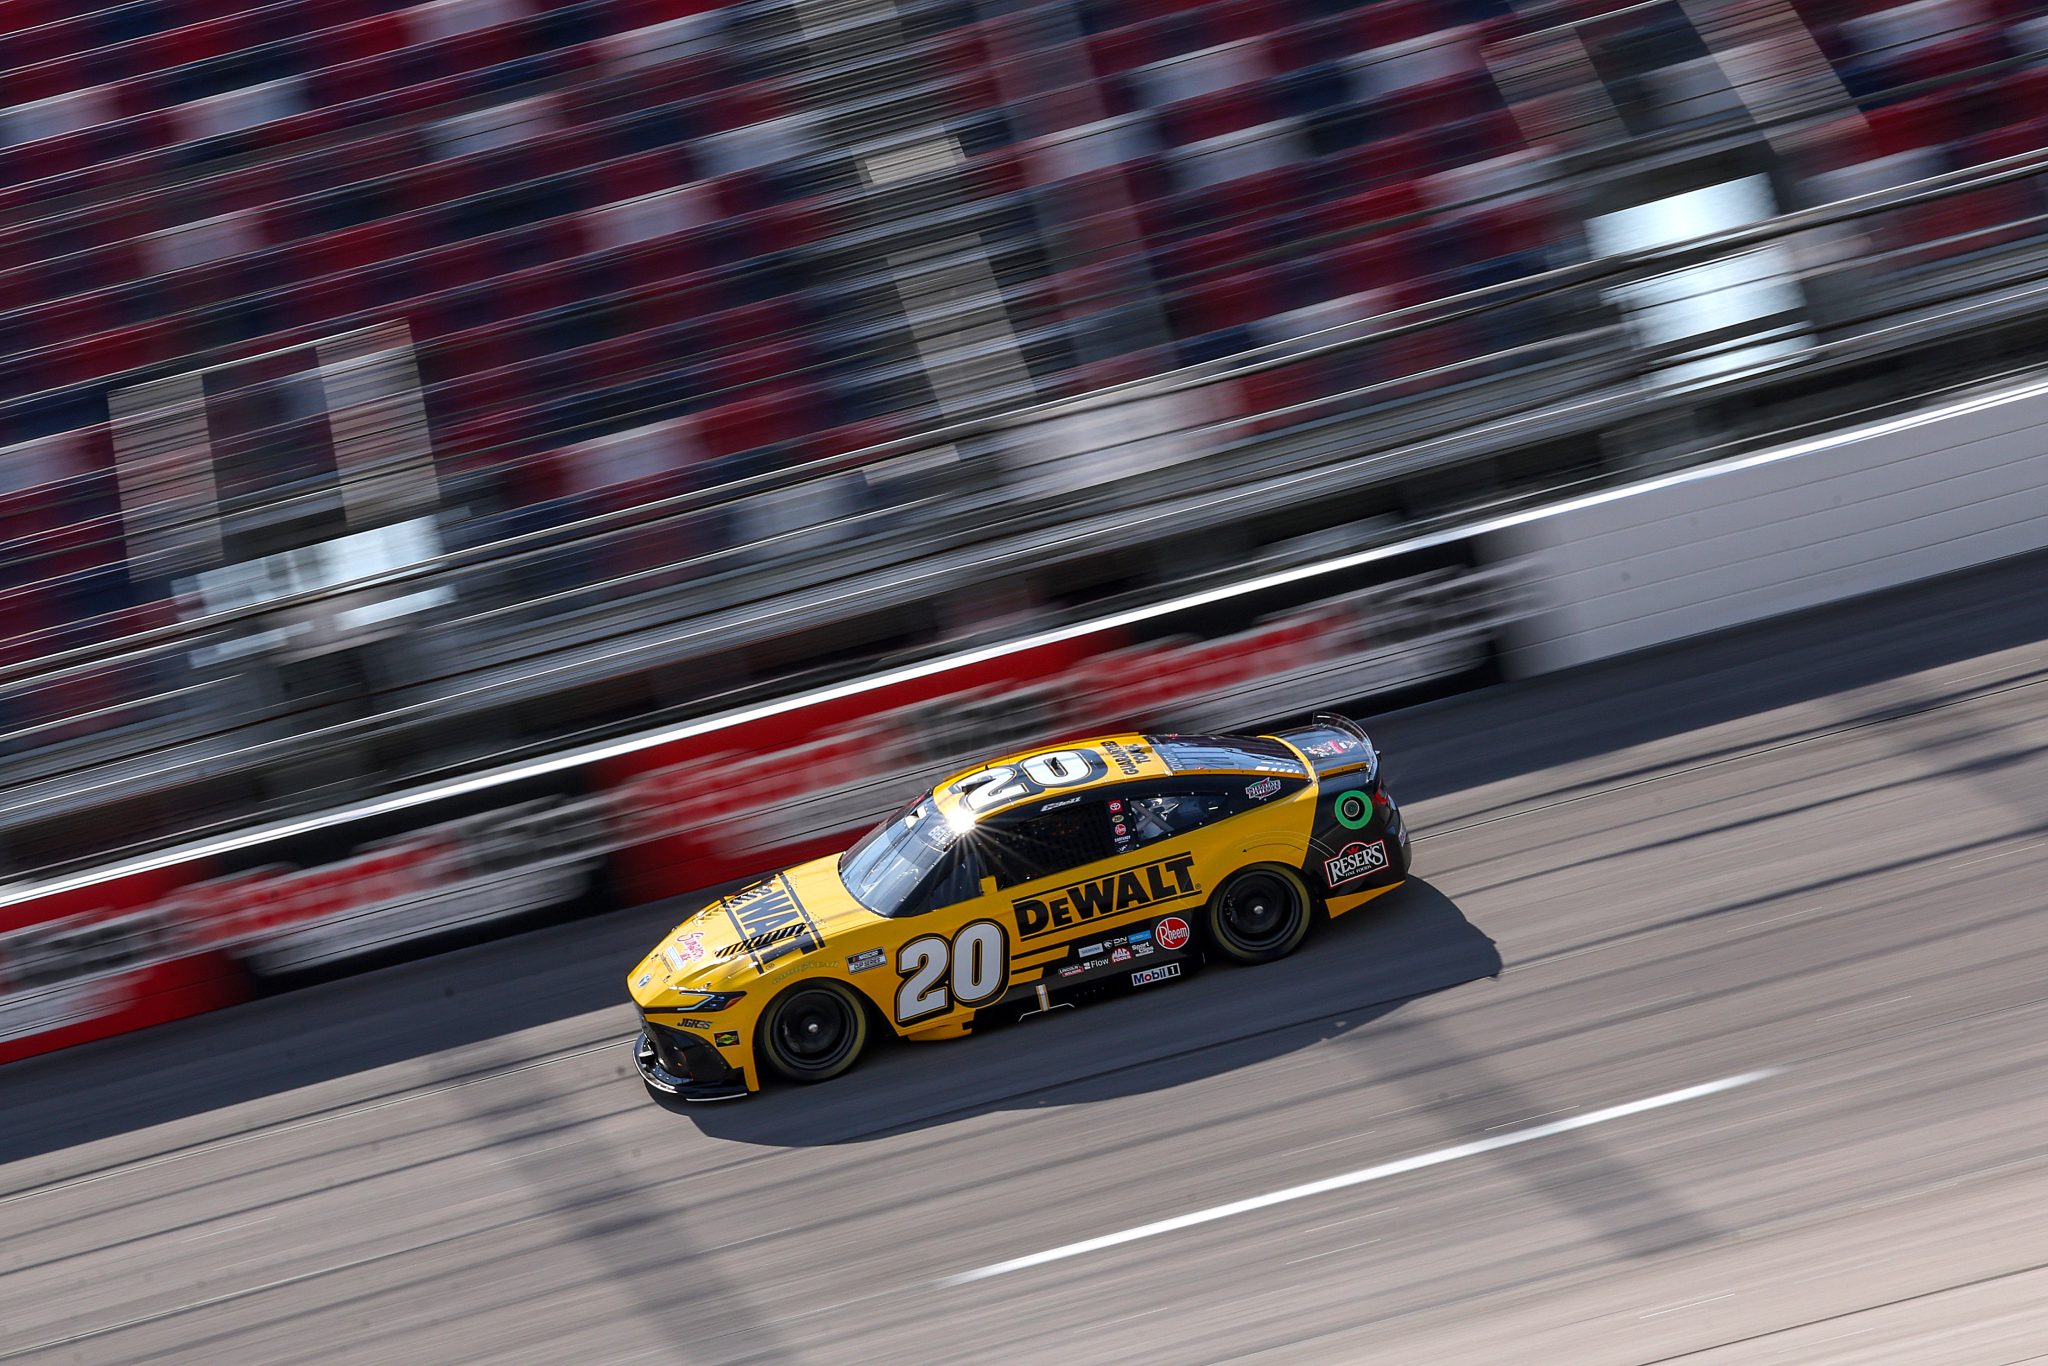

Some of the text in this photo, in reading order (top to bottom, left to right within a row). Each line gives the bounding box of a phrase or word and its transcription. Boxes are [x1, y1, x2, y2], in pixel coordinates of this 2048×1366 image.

[1101, 741, 1140, 776] GUARANTEED
[950, 750, 1097, 815] 20
[1329, 845, 1384, 883] RESER'S
[1158, 920, 1188, 946] Rheem
[859, 950, 879, 959] NASCAR
[1090, 958, 1109, 969] Flow
[1111, 947, 1131, 959] MAC
[896, 920, 1008, 1024] 20
[1133, 969, 1167, 985] Mobil
